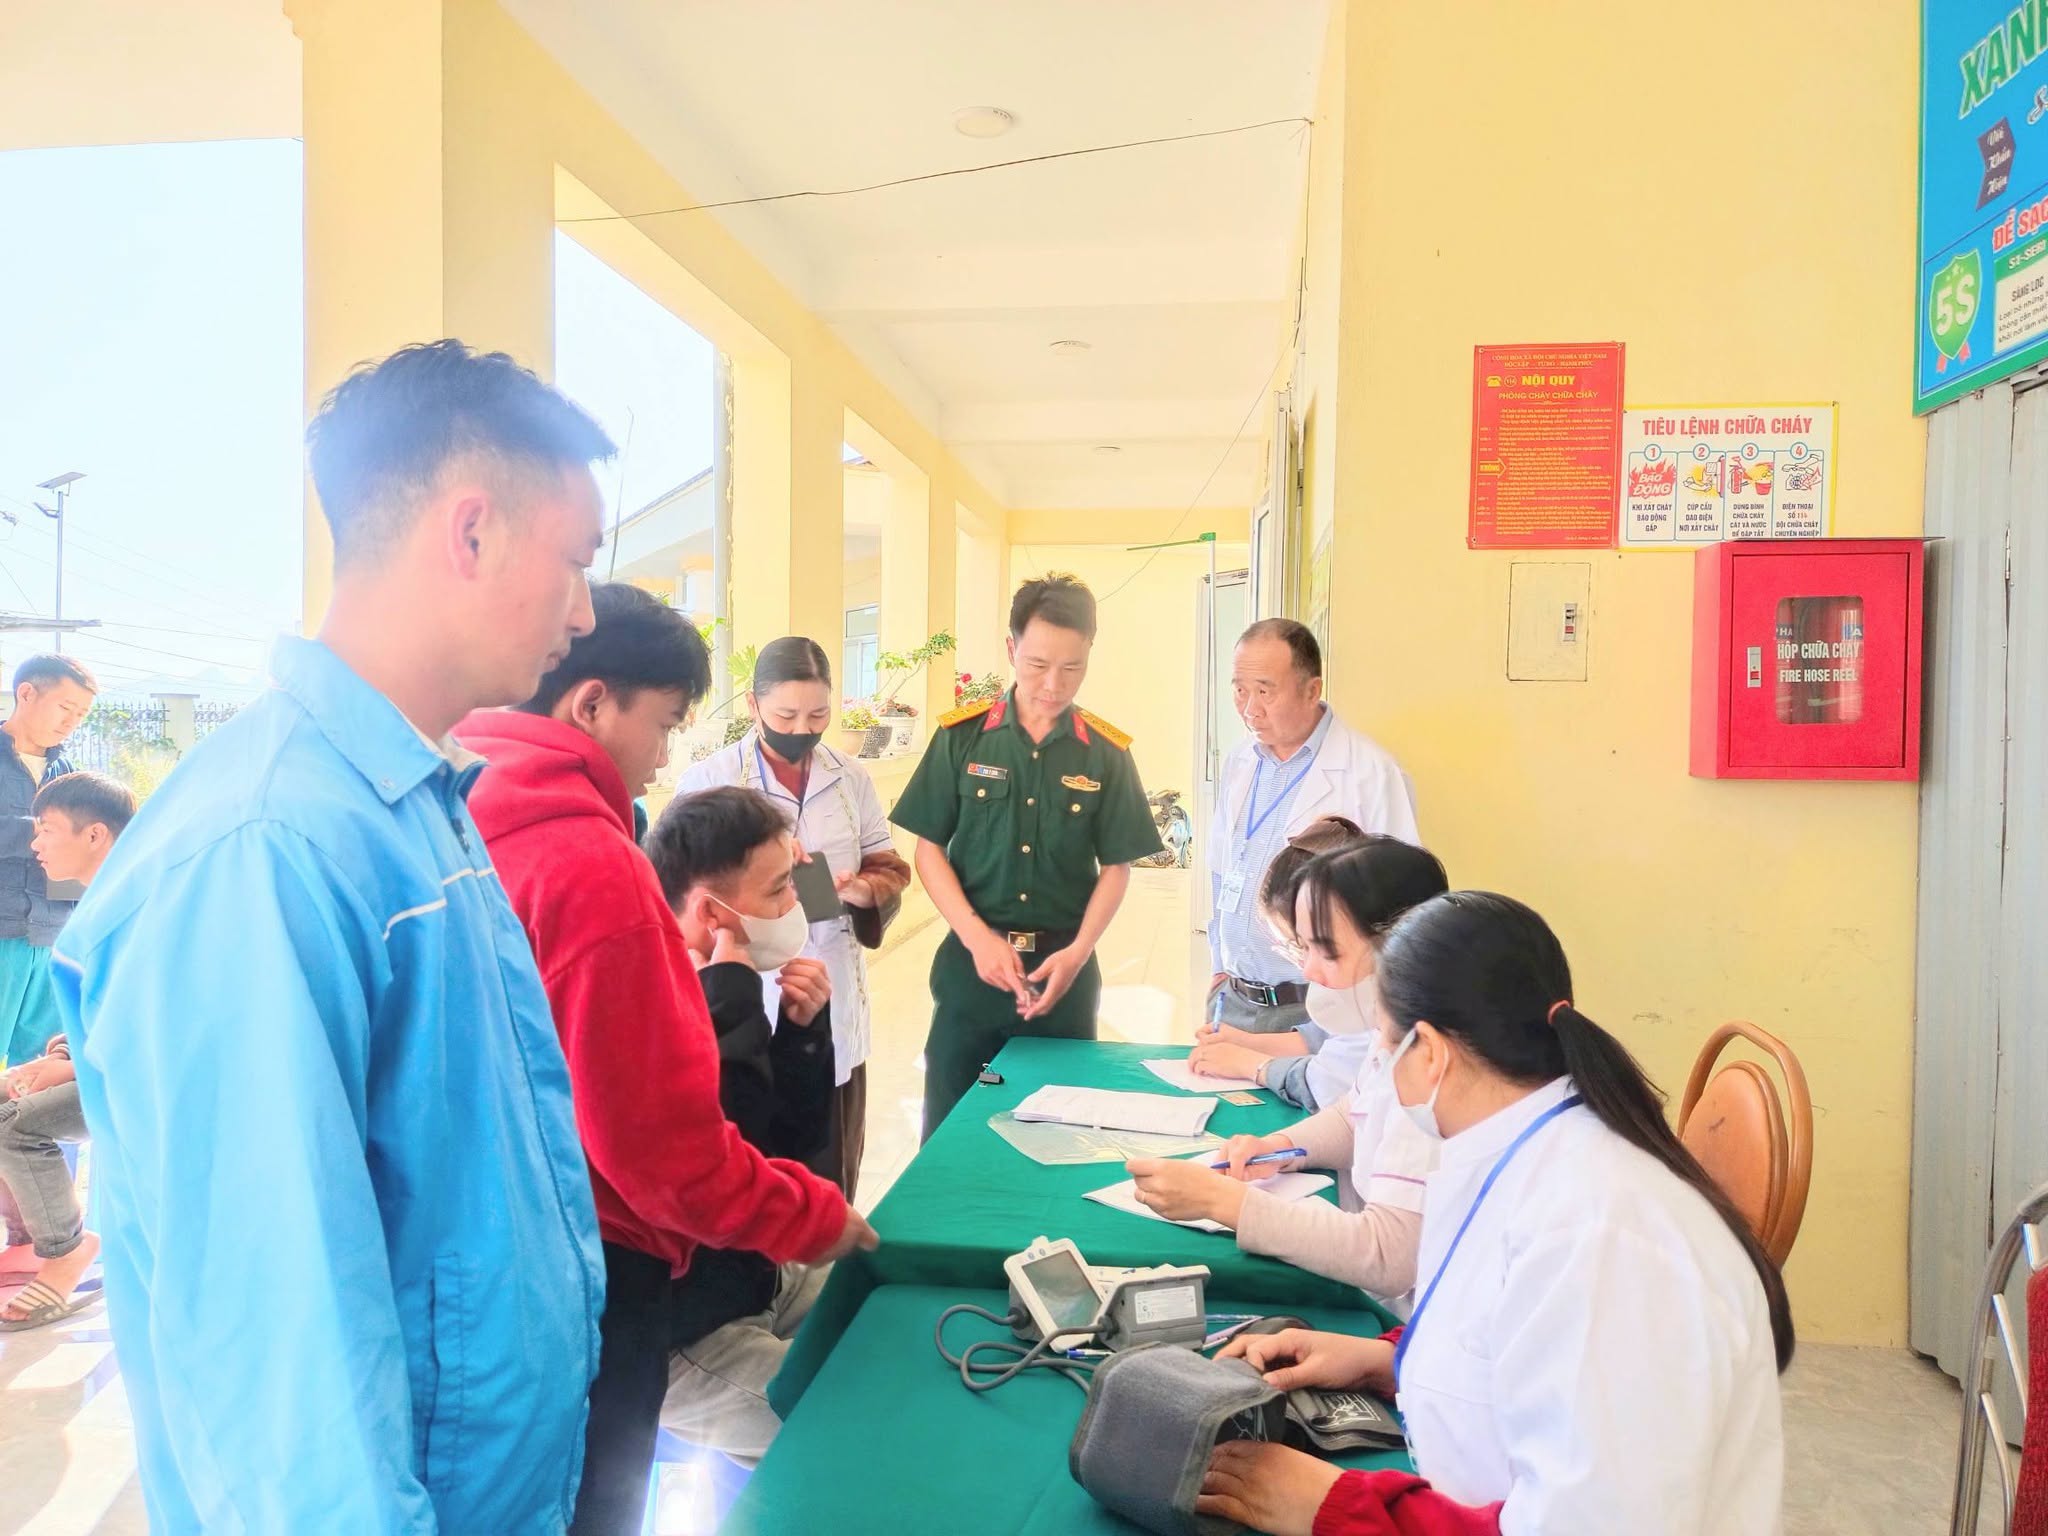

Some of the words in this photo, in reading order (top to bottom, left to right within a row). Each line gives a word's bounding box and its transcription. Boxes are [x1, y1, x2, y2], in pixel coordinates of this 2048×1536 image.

[1936, 273, 1975, 336] 5S
[1521, 374, 1545, 387] NỘI
[1549, 375, 1575, 386] QUY
[1499, 391, 1527, 399] PHÒNG
[1528, 390, 1551, 399] CHÁY
[1575, 390, 1599, 399] CHÁY
[1642, 417, 1675, 435] TIÊU
[1680, 417, 1719, 438] LỆNH
[1725, 415, 1766, 434] CHỮA
[1771, 414, 1812, 434] CHÁY
[1650, 447, 1656, 458] 1
[1698, 447, 1705, 457] 2
[1746, 446, 1754, 457] 3
[1795, 446, 1803, 456] 4
[1632, 482, 1672, 499] ĐỘNG
[1777, 640, 1798, 663] HỘP
[1801, 640, 1830, 659] CHỮA
[1780, 669, 1801, 683] FIRE
[1804, 669, 1830, 682] HOSE
[1833, 669, 1858, 682] REEL
